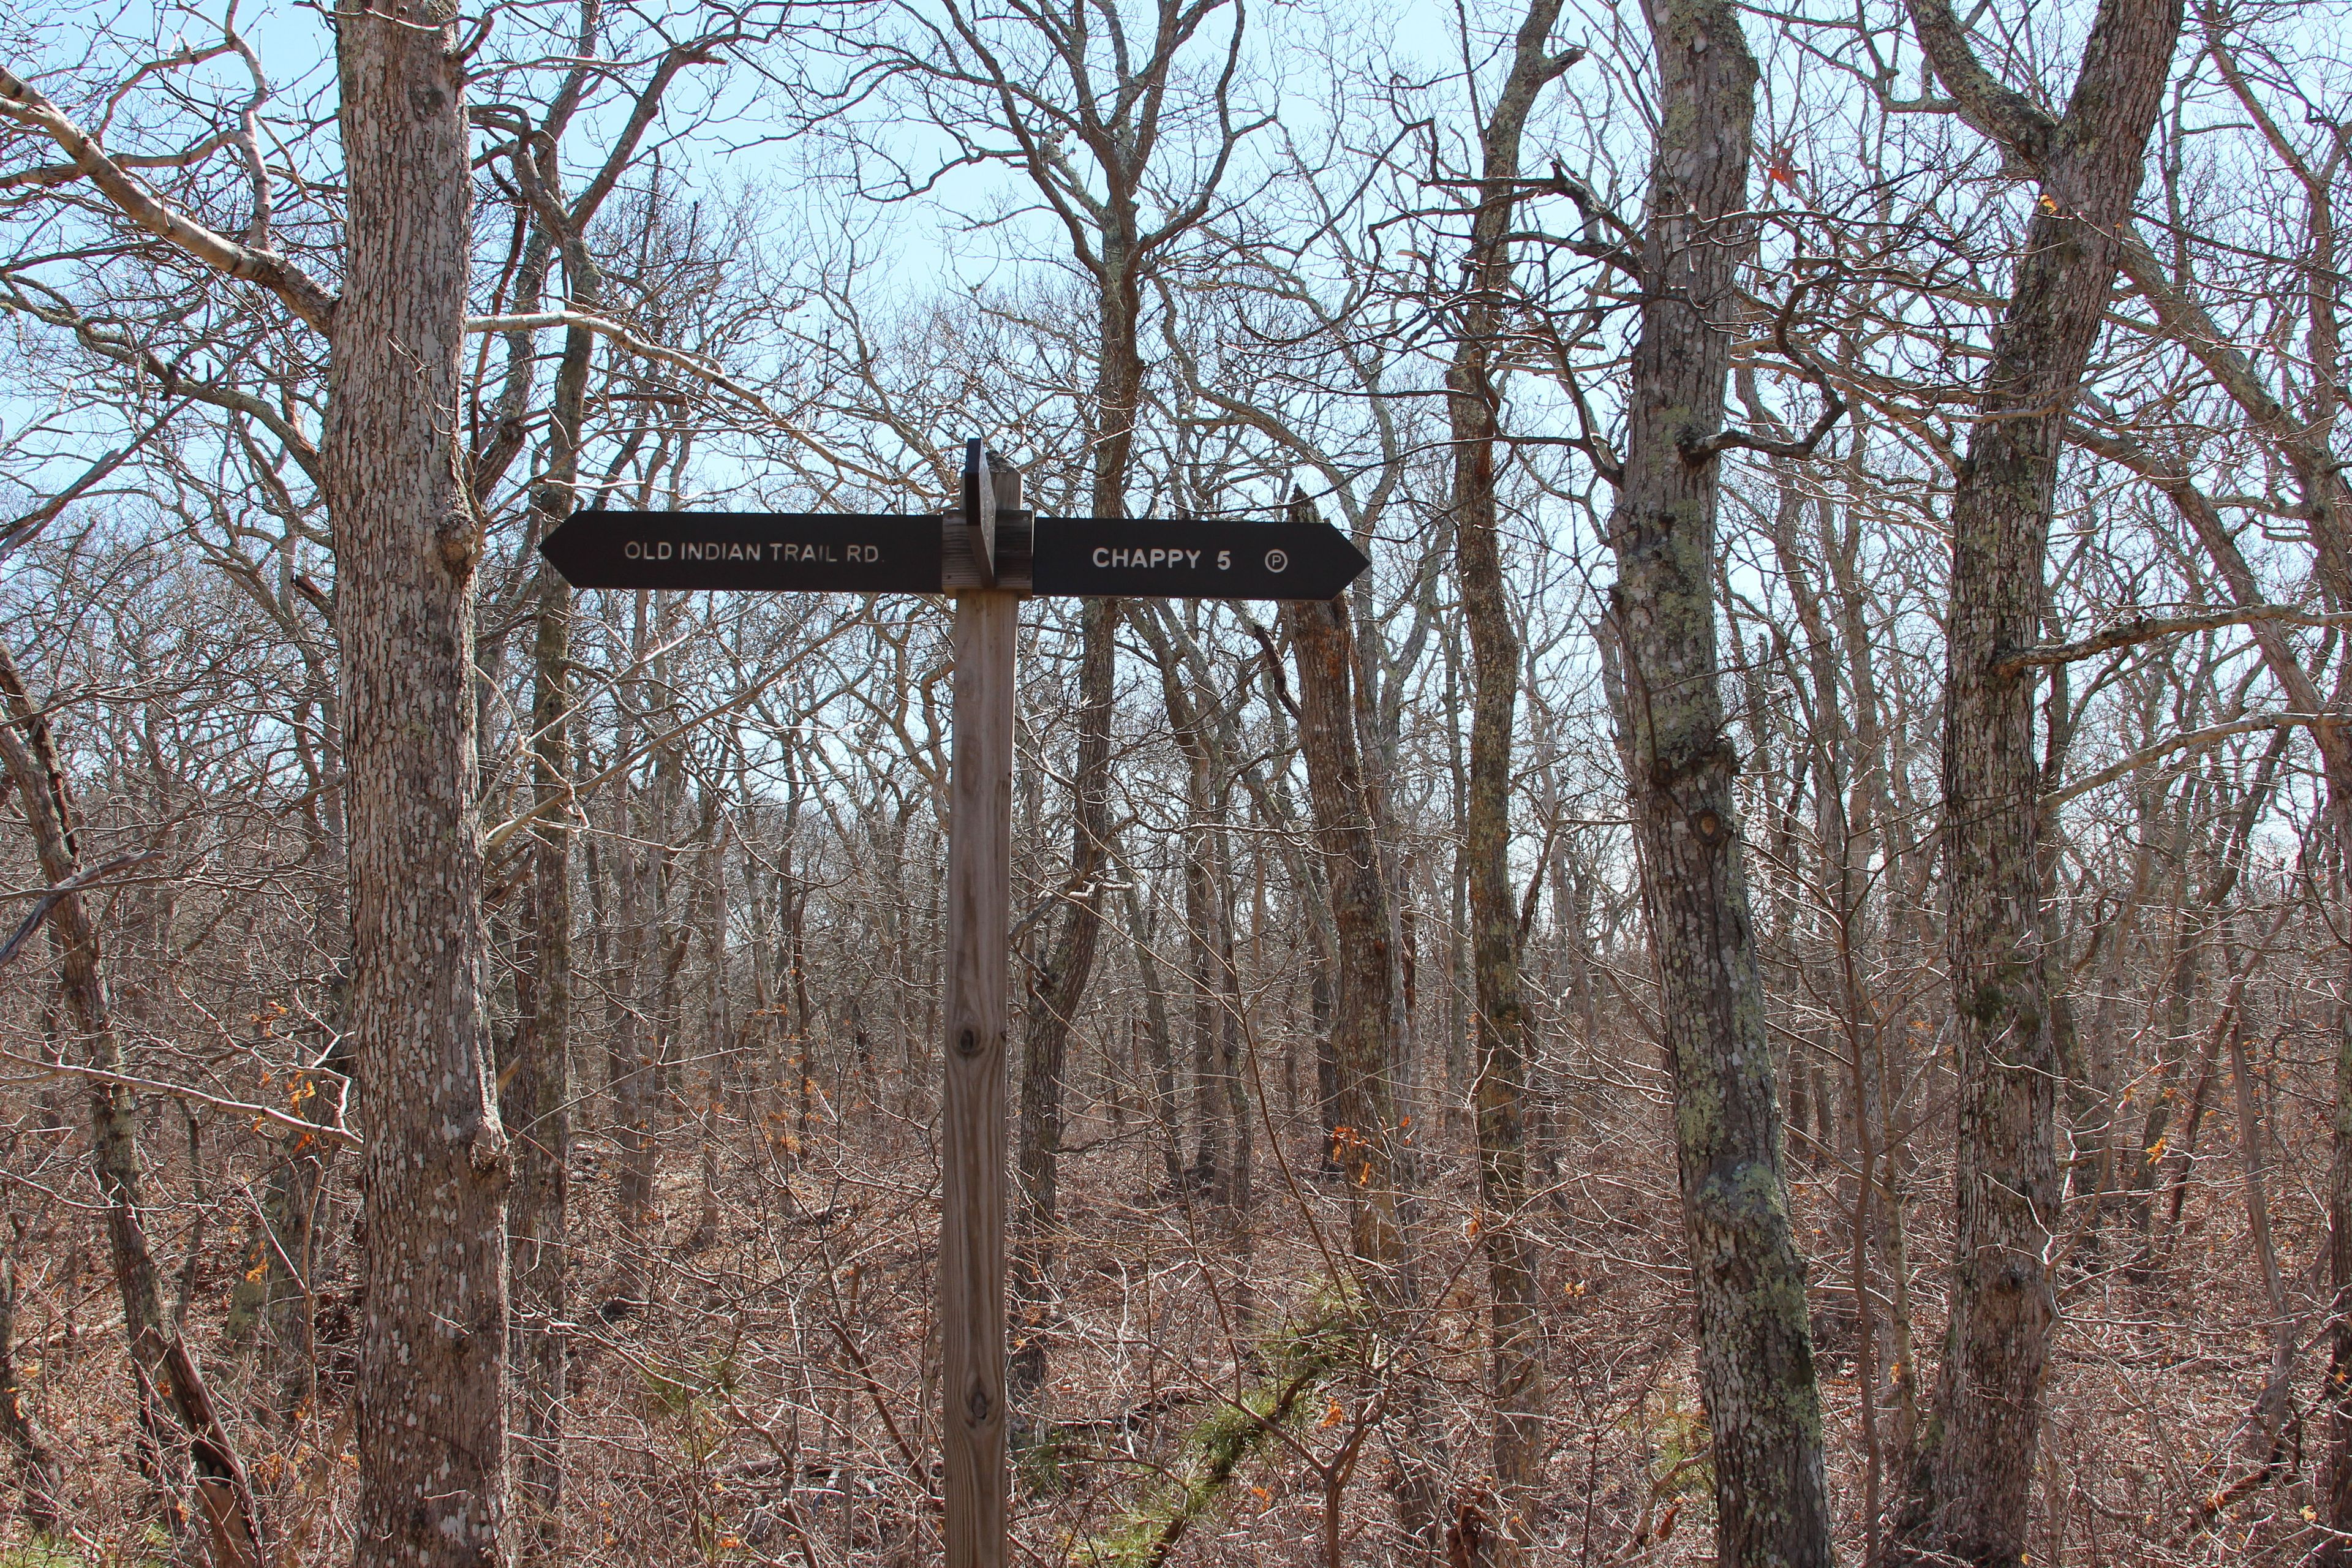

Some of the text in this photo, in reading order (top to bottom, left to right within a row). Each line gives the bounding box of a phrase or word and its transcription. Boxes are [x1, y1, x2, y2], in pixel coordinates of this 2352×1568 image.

[625, 541, 672, 559] OLD
[681, 543, 760, 560] INDIAN
[769, 543, 837, 562] TRAIL
[1093, 548, 1200, 568] CHAPPY
[1217, 551, 1231, 570] 5
